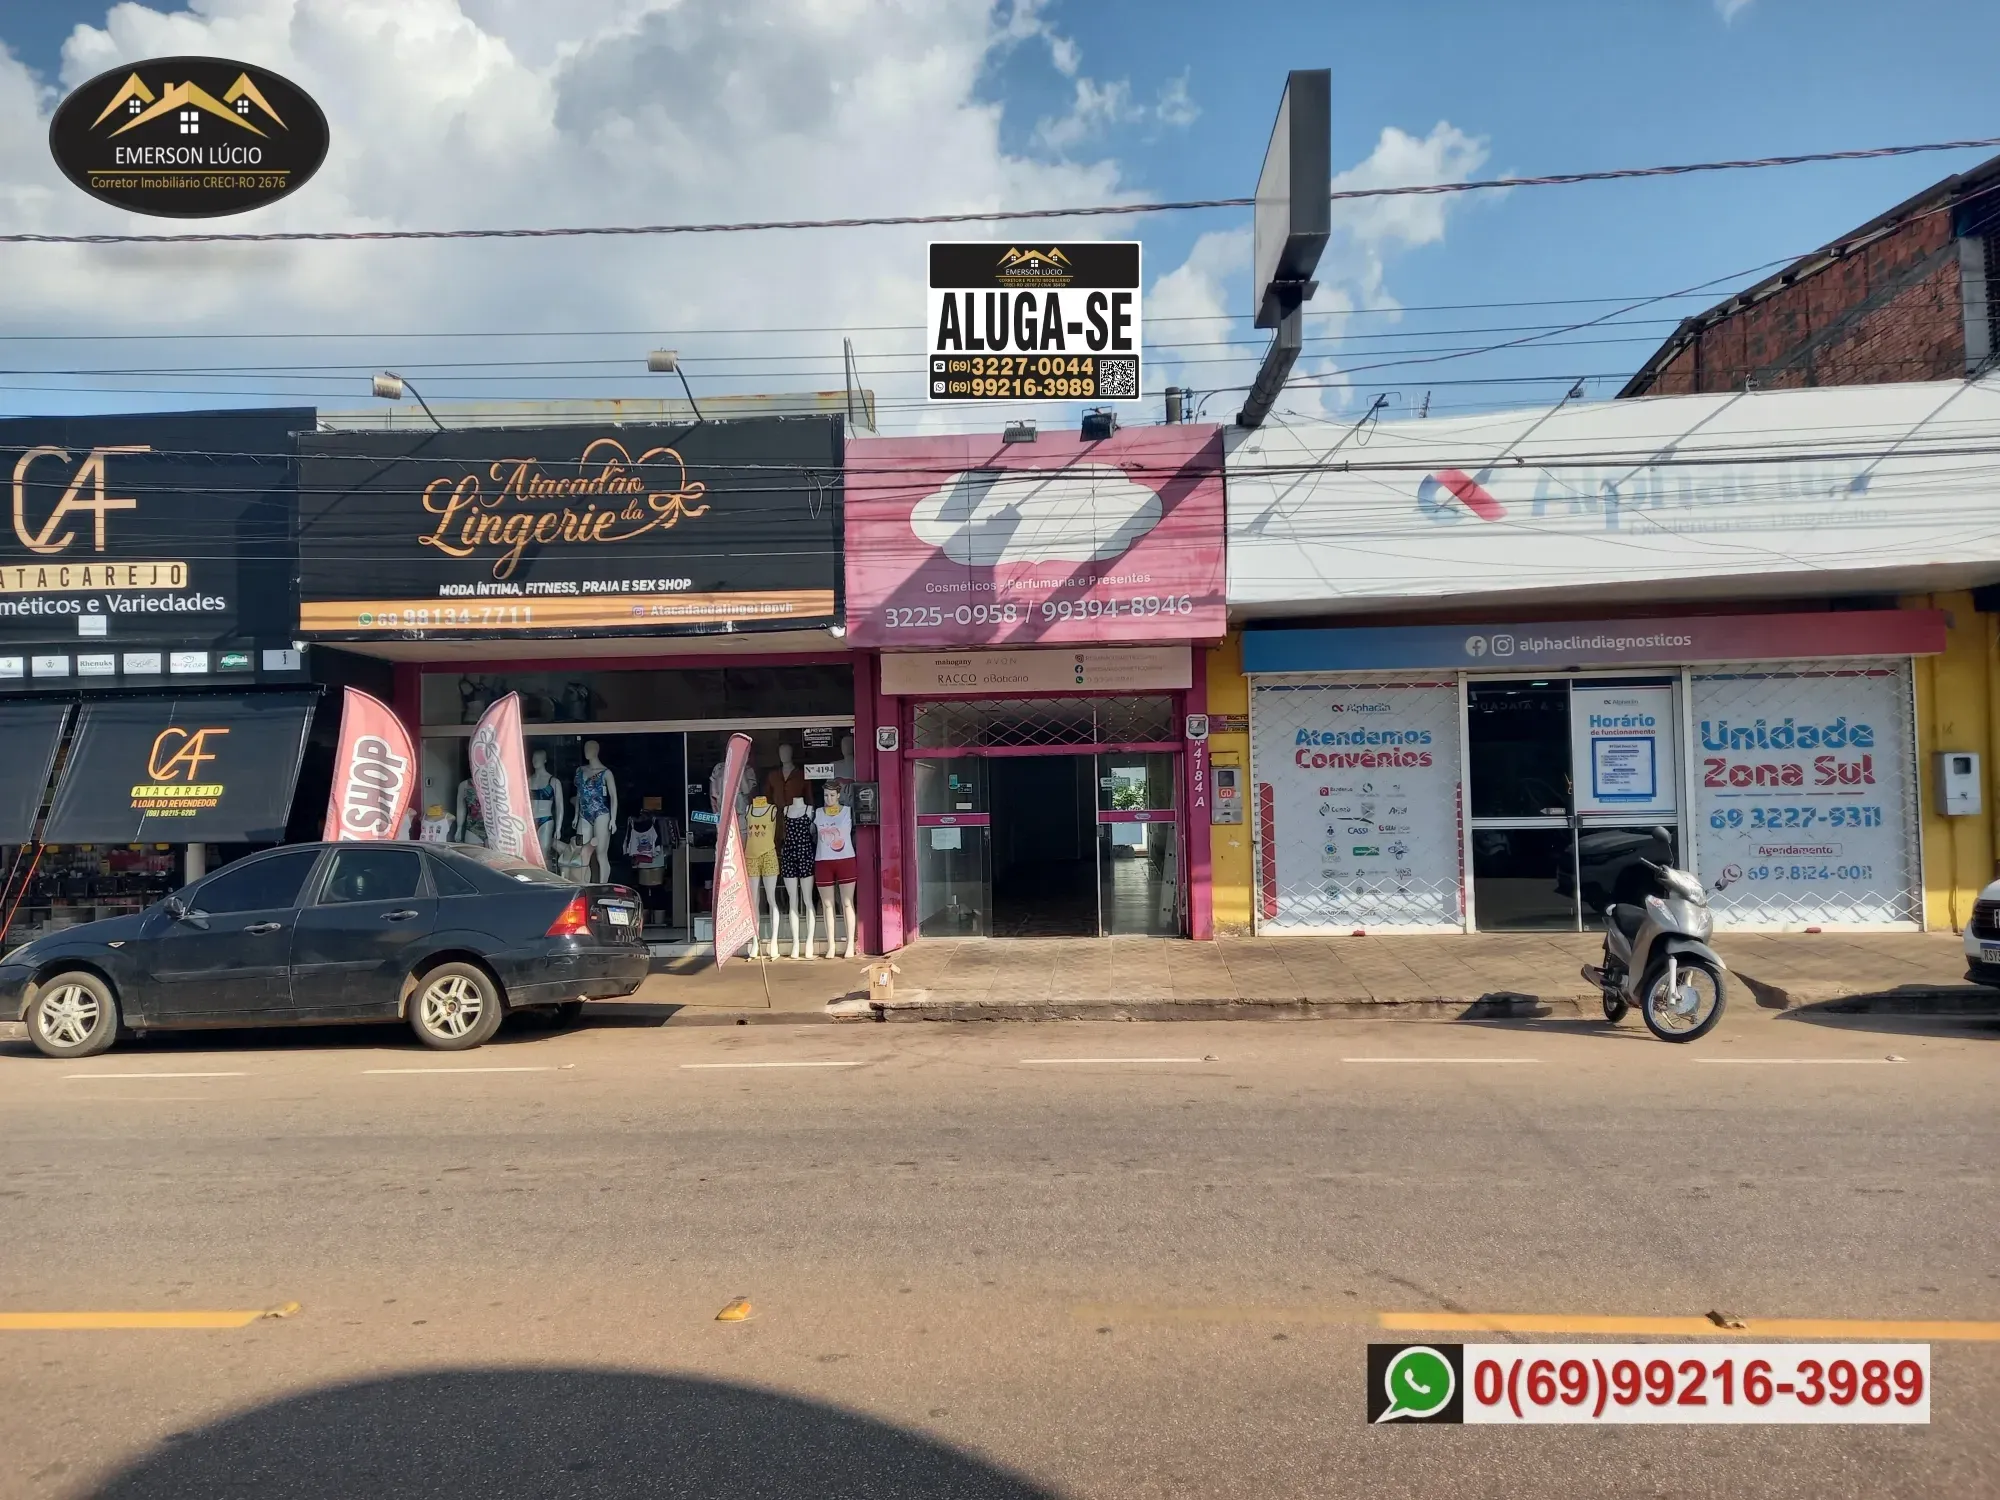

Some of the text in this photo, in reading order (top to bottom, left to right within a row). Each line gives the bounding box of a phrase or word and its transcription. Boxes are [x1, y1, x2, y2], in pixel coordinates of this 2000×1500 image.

[620, 498, 645, 520] da
[417, 475, 618, 580] Lingerie
[439, 578, 692, 597] MODA ÍNTIMA, FITNESS, PRAIA E SEX SHOP
[925, 581, 996, 593] Cosméticos
[1007, 575, 1075, 589] Perfumaria
[1078, 578, 1086, 587] e
[1089, 573, 1151, 586] Presentes
[86, 598, 100, 612] e
[105, 593, 226, 613] Variedades
[885, 603, 1018, 628] 3225-0958
[1041, 594, 1193, 623] 99394-8946
[377, 606, 533, 627] 69 98134-7711
[1519, 633, 1692, 653] alphaclindiagnosticos
[935, 657, 1018, 666] mahogany AVON
[937, 673, 977, 684] RACCO
[1590, 714, 1656, 728] Horário
[1296, 727, 1432, 746] Atendemos
[1601, 728, 1656, 736] funcionamento
[1701, 716, 1875, 750] Unidade
[1295, 747, 1433, 769] Convênios
[1703, 753, 1876, 788] Zona Sul
[134, 787, 220, 796] ATACAREJO
[345, 738, 403, 835] SHOP
[1220, 789, 1232, 798] GD
[138, 800, 155, 808] LOJA
[156, 800, 167, 808] DO
[168, 799, 217, 808] REVENDEDOR
[693, 812, 719, 823] ABERTO
[1710, 806, 1881, 829] 69 3227-9311
[1758, 845, 1833, 857] Agendamento
[1748, 866, 1770, 880] 69
